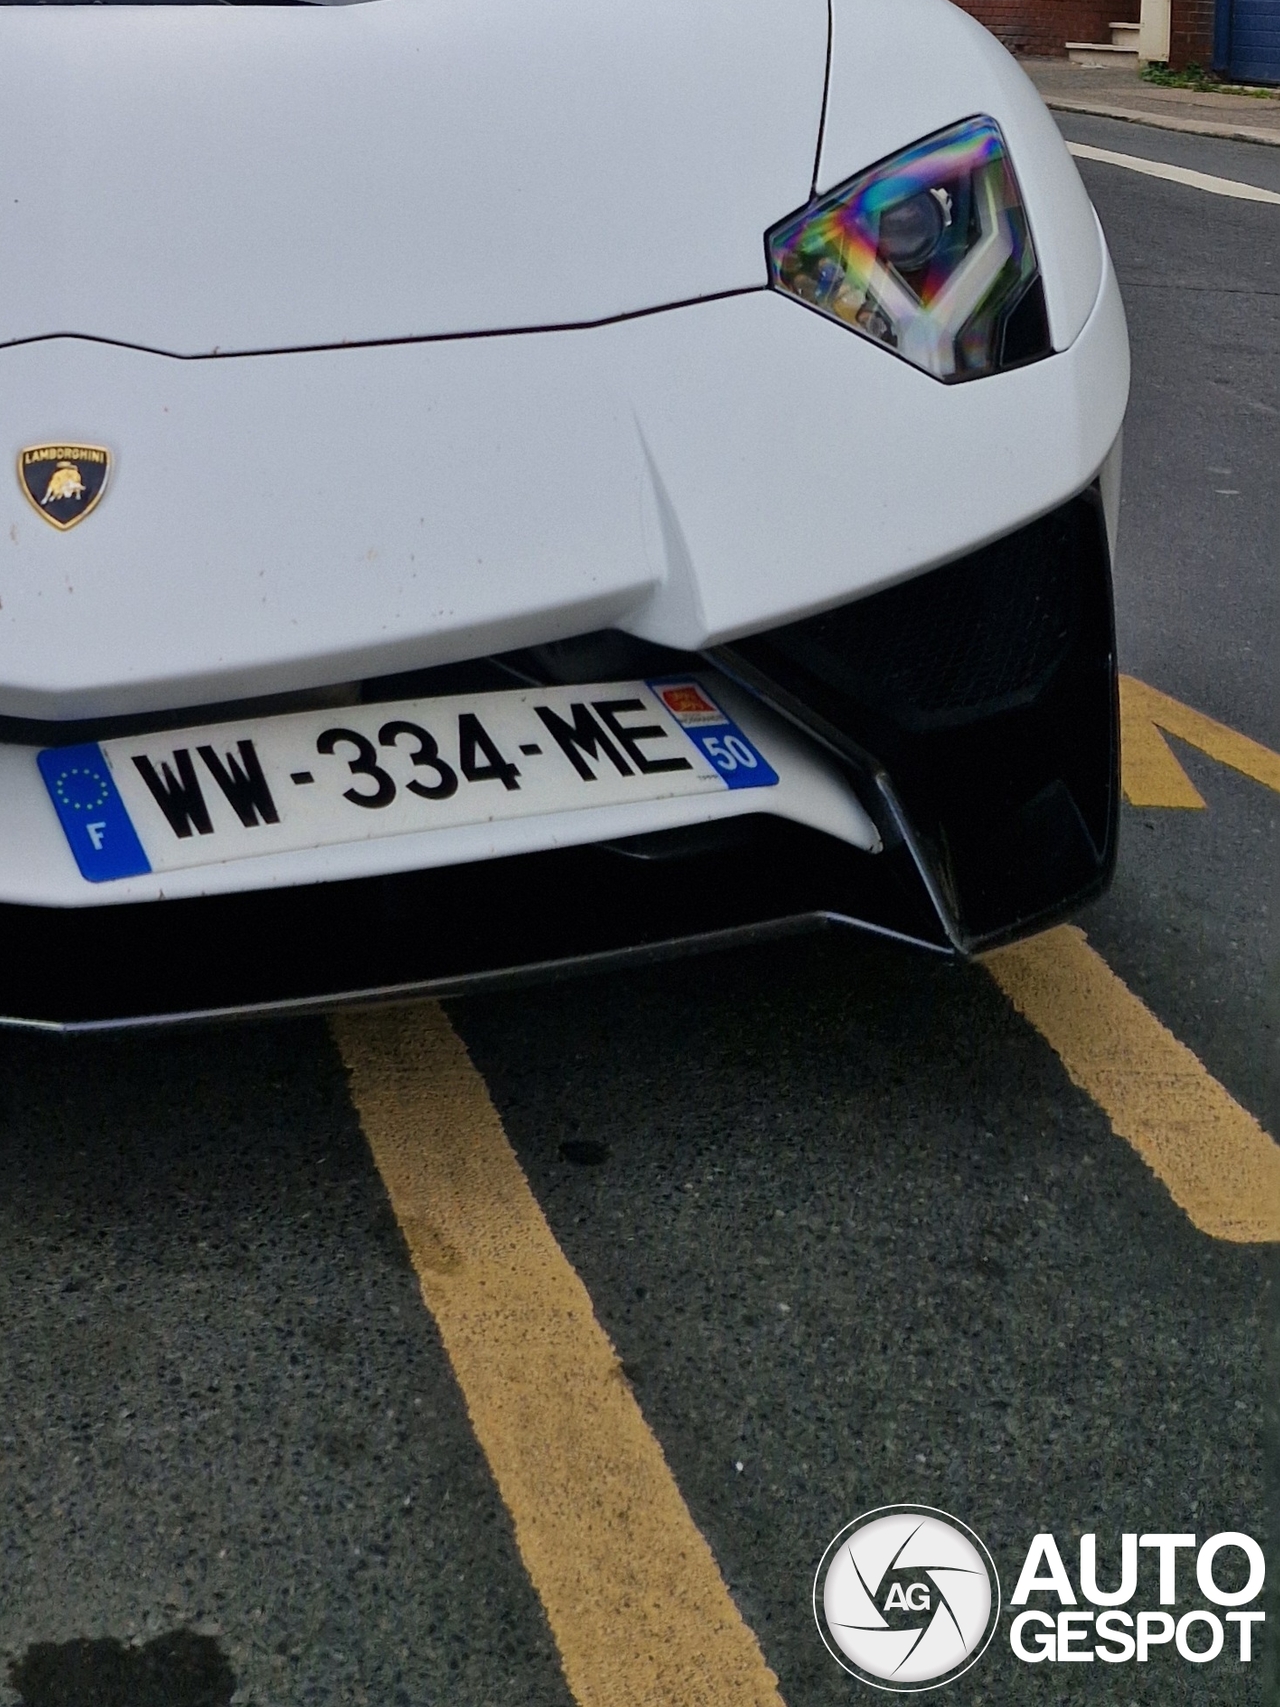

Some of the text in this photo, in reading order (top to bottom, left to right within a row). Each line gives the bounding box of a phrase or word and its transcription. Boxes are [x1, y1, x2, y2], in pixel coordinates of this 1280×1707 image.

[25, 448, 104, 464] LAMBORGHINI
[130, 698, 694, 839] WW-334-ME
[702, 735, 758, 771] 50
[85, 821, 107, 851] F
